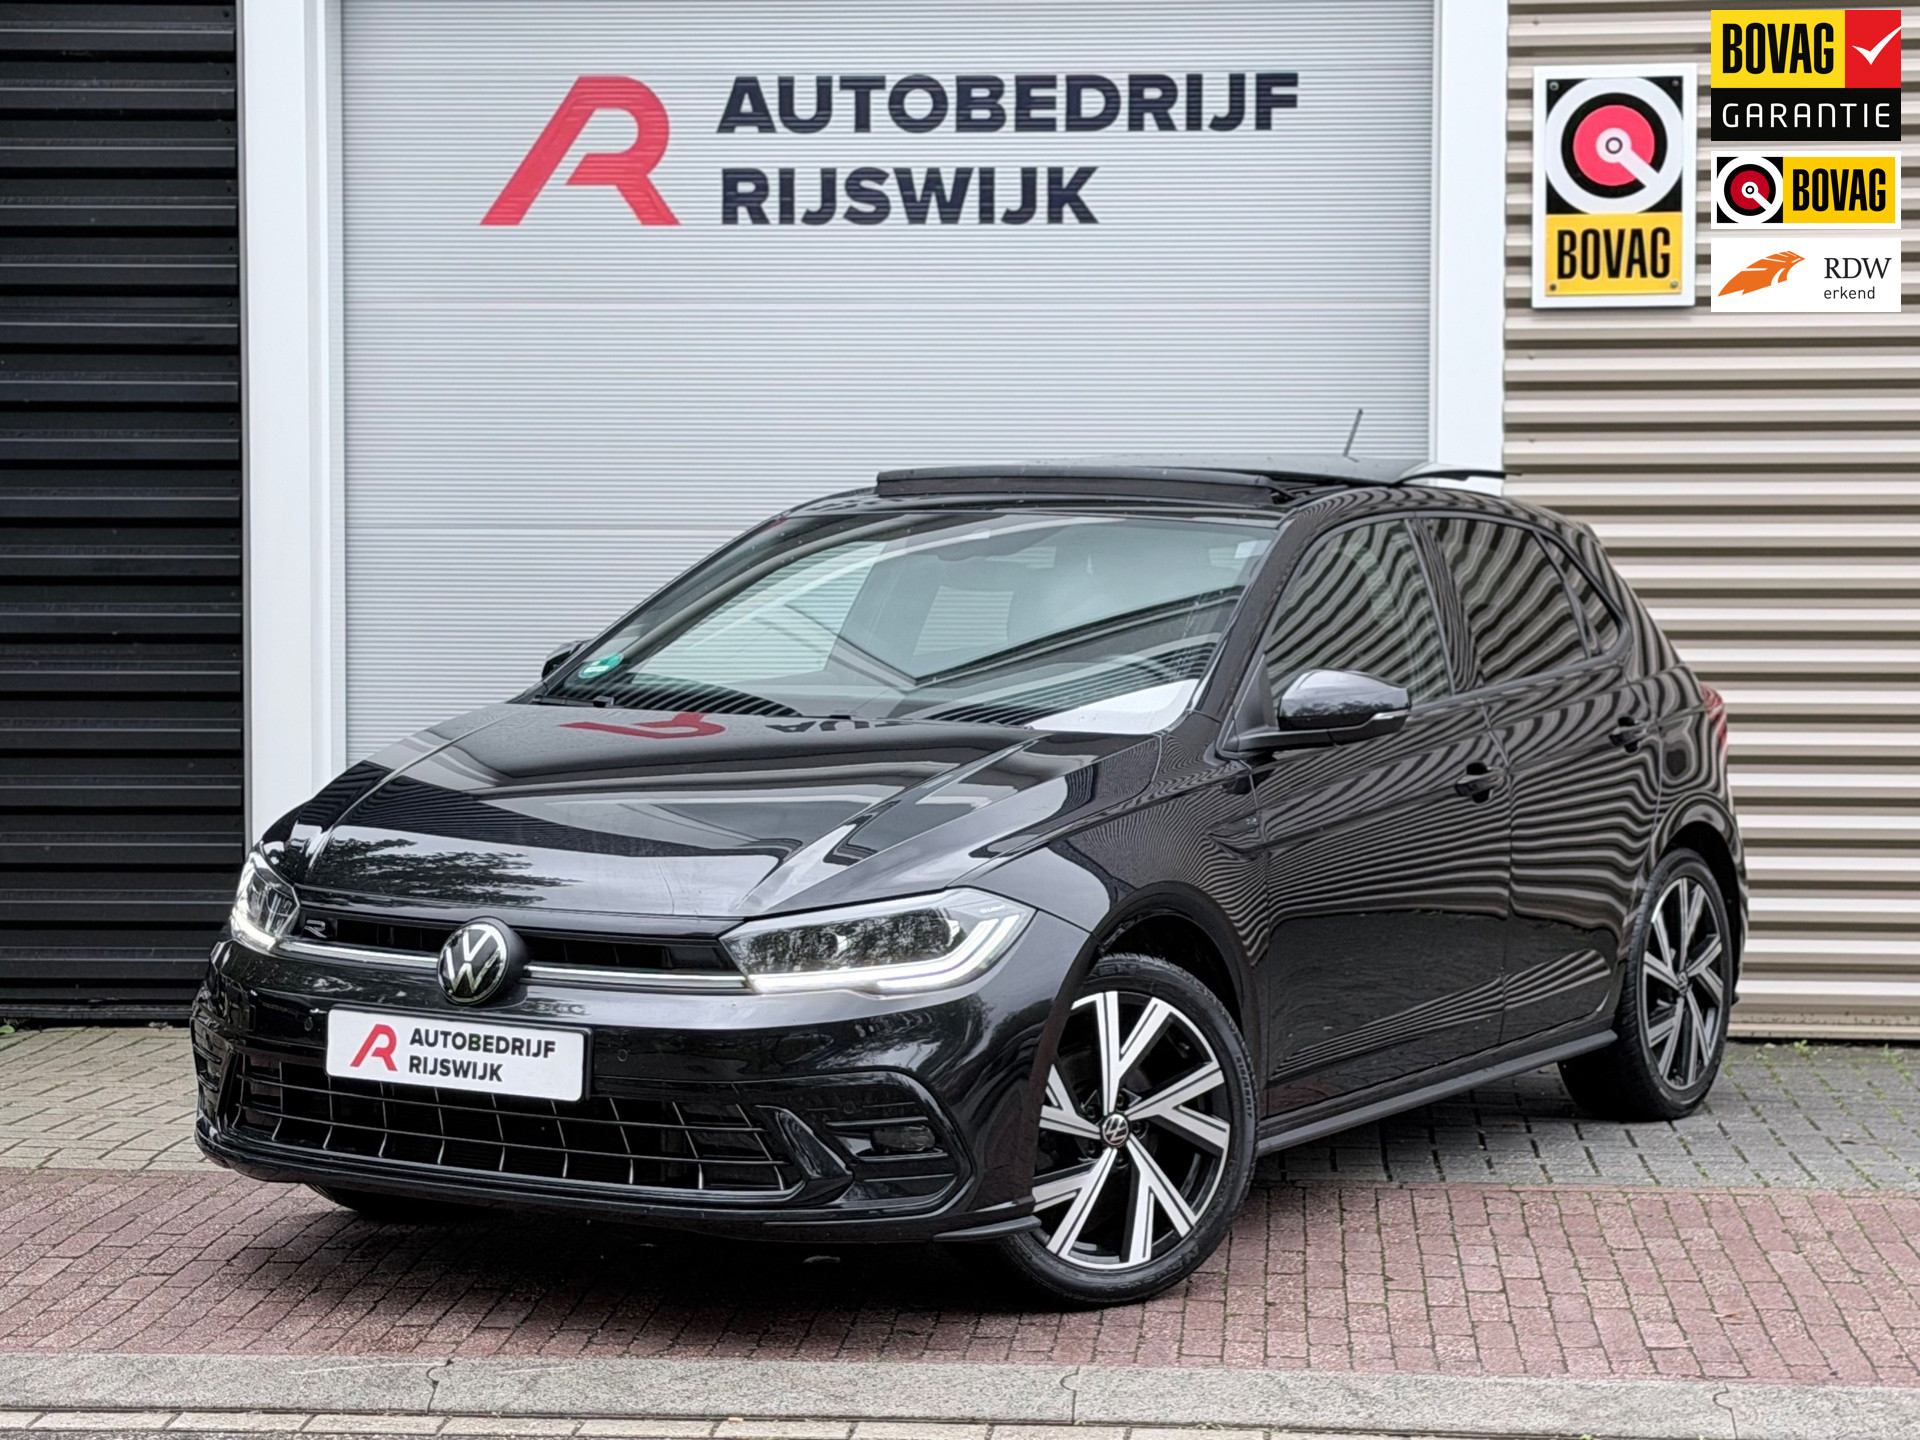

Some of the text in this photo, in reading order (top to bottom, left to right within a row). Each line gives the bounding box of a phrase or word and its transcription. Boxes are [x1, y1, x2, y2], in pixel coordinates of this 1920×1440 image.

[716, 72, 1299, 134] AUTOBEDRIJF
[721, 166, 1100, 226] RIJSWIJK
[1556, 226, 1671, 281] BOVAG
[408, 1055, 504, 1082] RIJSWIJK
[409, 1028, 556, 1059] AUTOBEDRIJF
